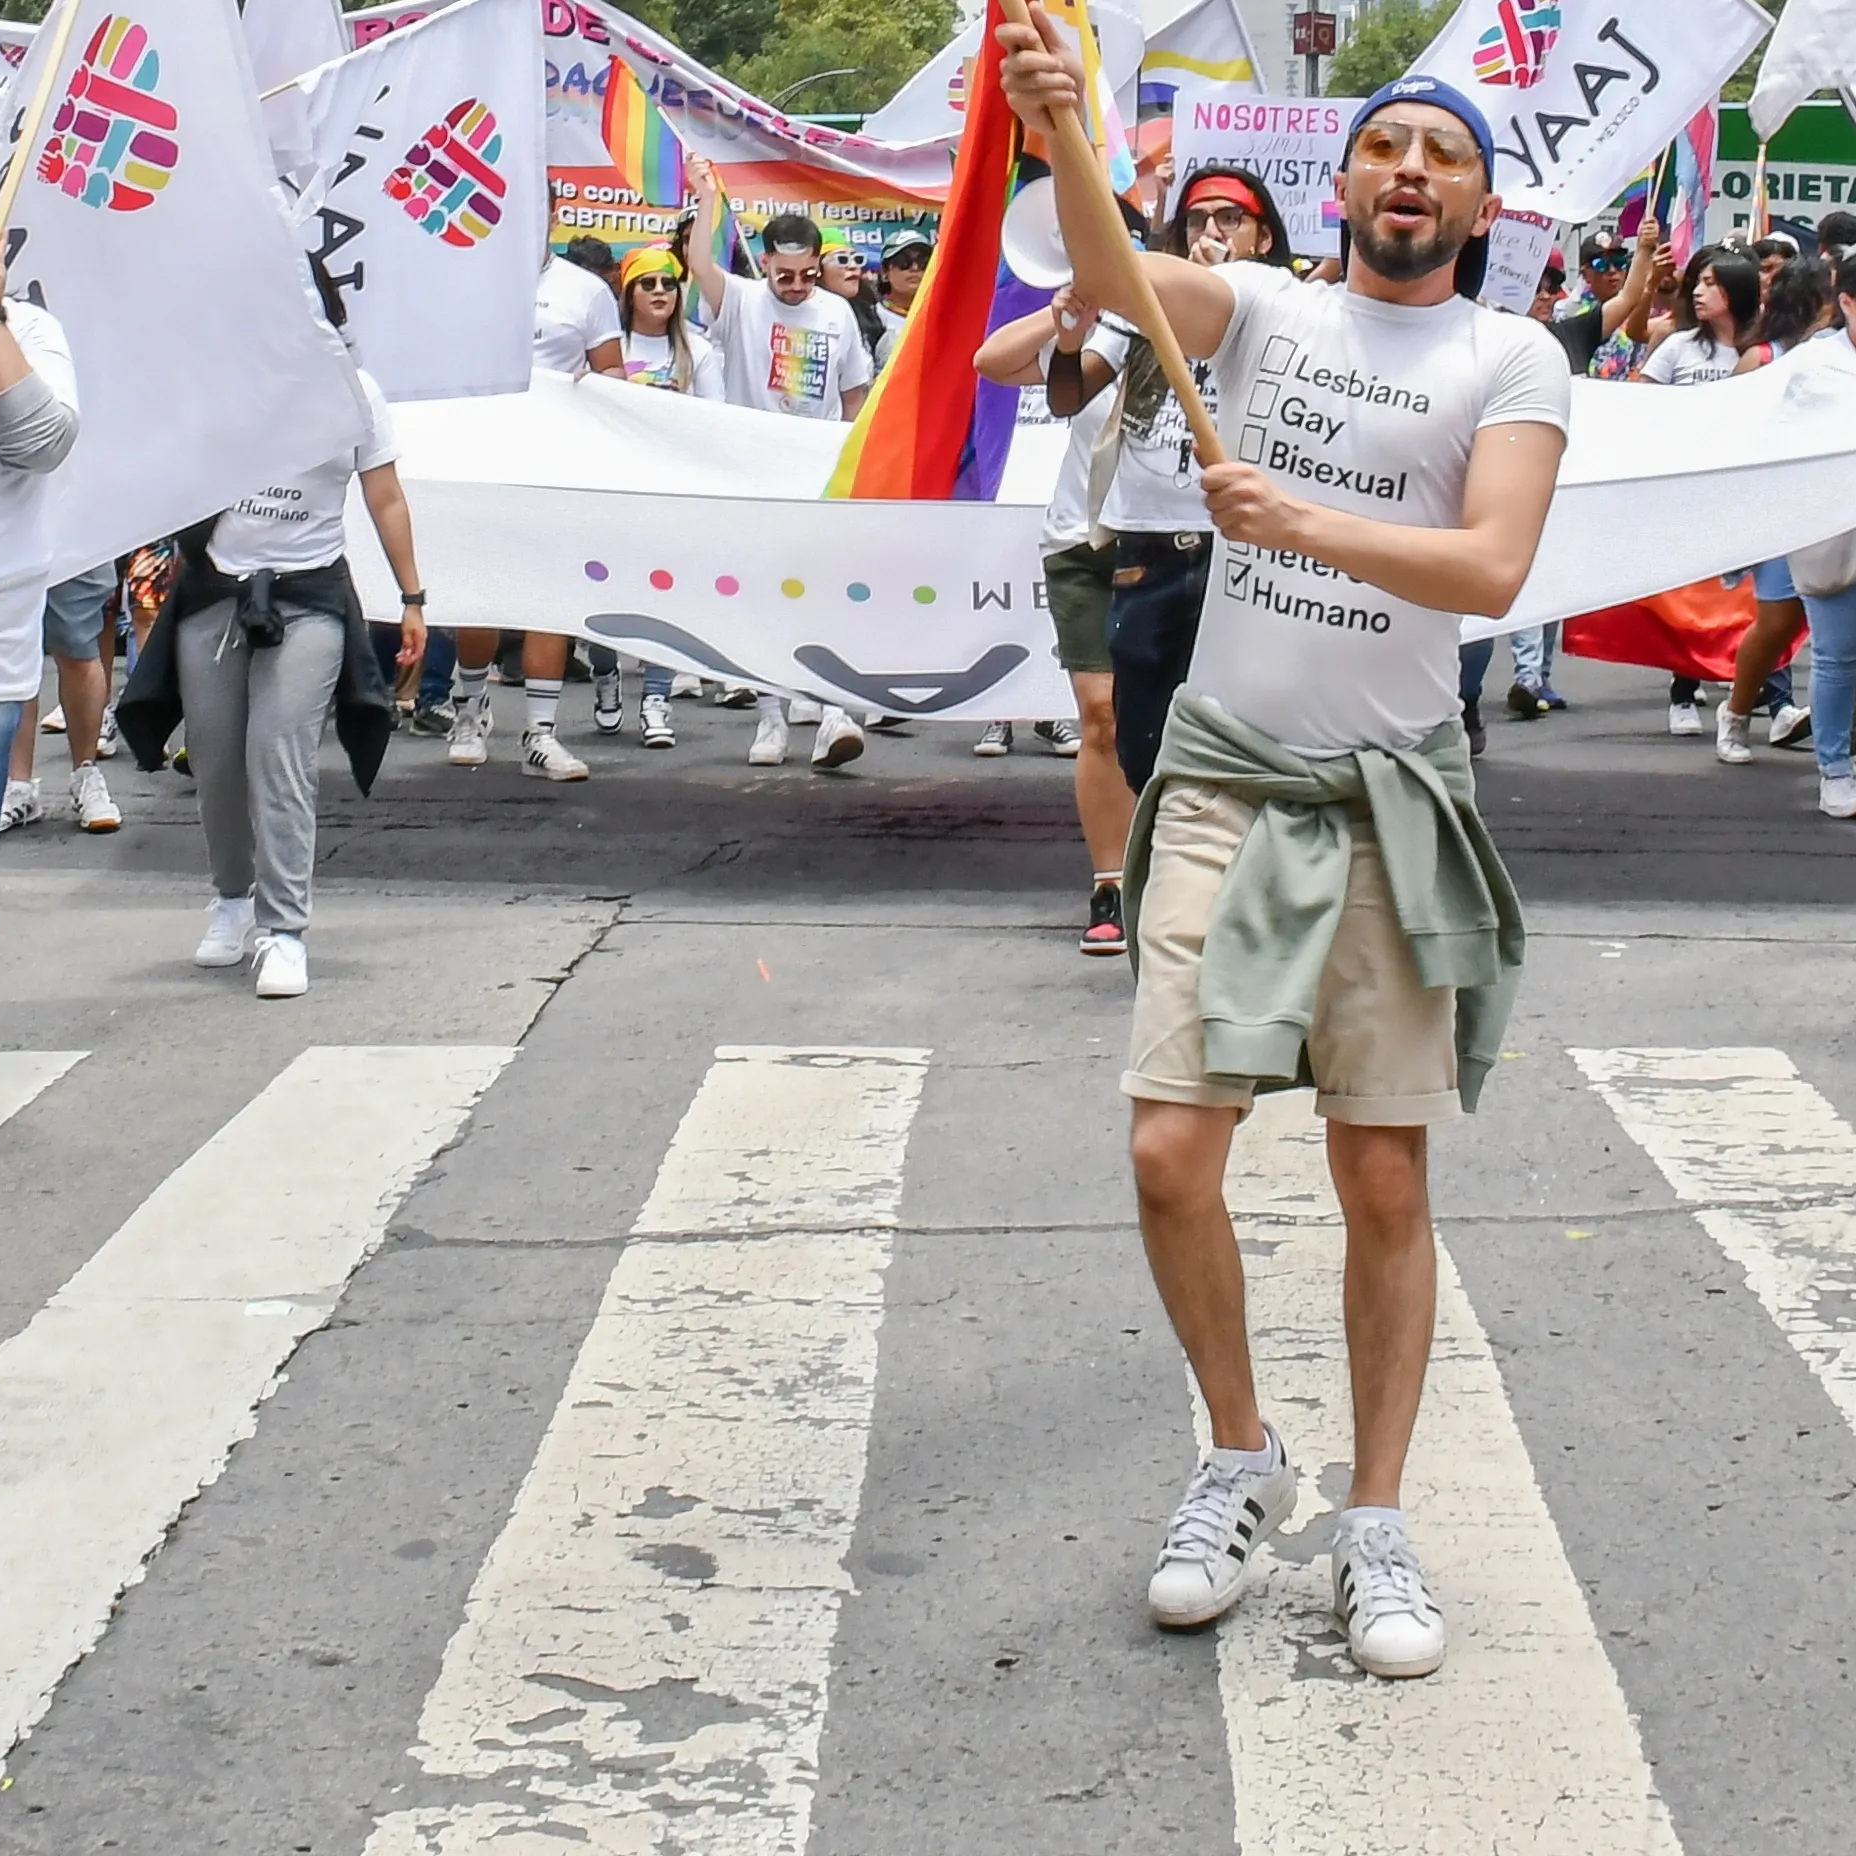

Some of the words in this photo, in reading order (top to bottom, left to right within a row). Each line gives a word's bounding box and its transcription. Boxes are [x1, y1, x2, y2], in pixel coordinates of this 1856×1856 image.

[1194, 102, 1340, 135] NOSOTRES
[1494, 17, 1661, 189] YAAJ
[752, 197, 810, 219] nivel
[819, 200, 903, 224] federal
[1294, 354, 1431, 416] Lesbiana
[1279, 396, 1347, 445] Gay
[1268, 440, 1408, 502] Bisexual
[237, 497, 310, 523] Humano
[1252, 576, 1392, 634] Humano
